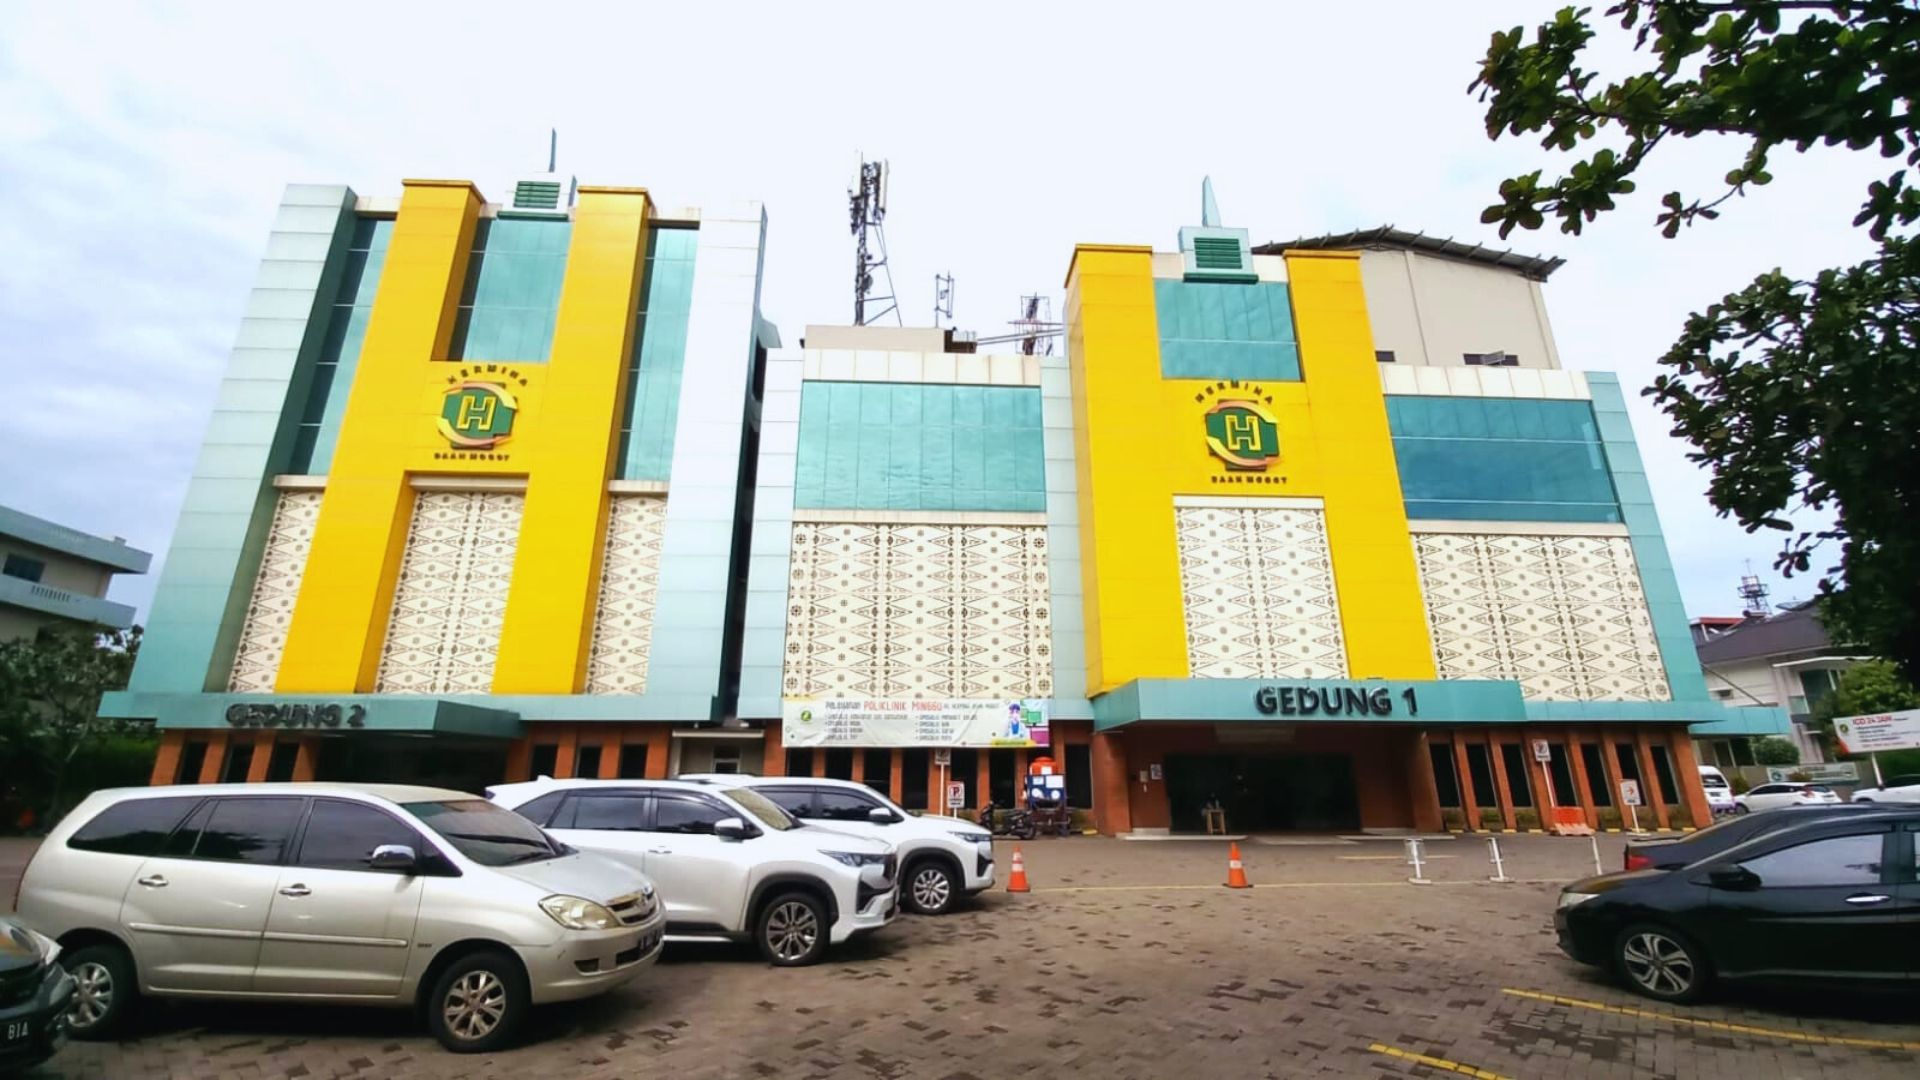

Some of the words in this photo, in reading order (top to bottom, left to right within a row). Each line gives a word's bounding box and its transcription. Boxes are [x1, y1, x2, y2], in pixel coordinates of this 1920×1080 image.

[446, 364, 528, 387] HERMINA
[1195, 380, 1273, 404] HERMINA
[456, 395, 497, 432] H
[1225, 414, 1262, 452] H
[434, 452, 466, 460] DAAN
[469, 453, 510, 461] MOGOT
[1211, 475, 1243, 483] DAAN
[1246, 476, 1287, 484] MOGOT
[863, 700, 906, 711] POLIKLINIK
[911, 700, 942, 711] MINGGU
[1255, 685, 1393, 717] GEDUNG
[1402, 686, 1418, 716] 1
[225, 702, 343, 728] GEDUNG
[347, 703, 366, 728] 2
